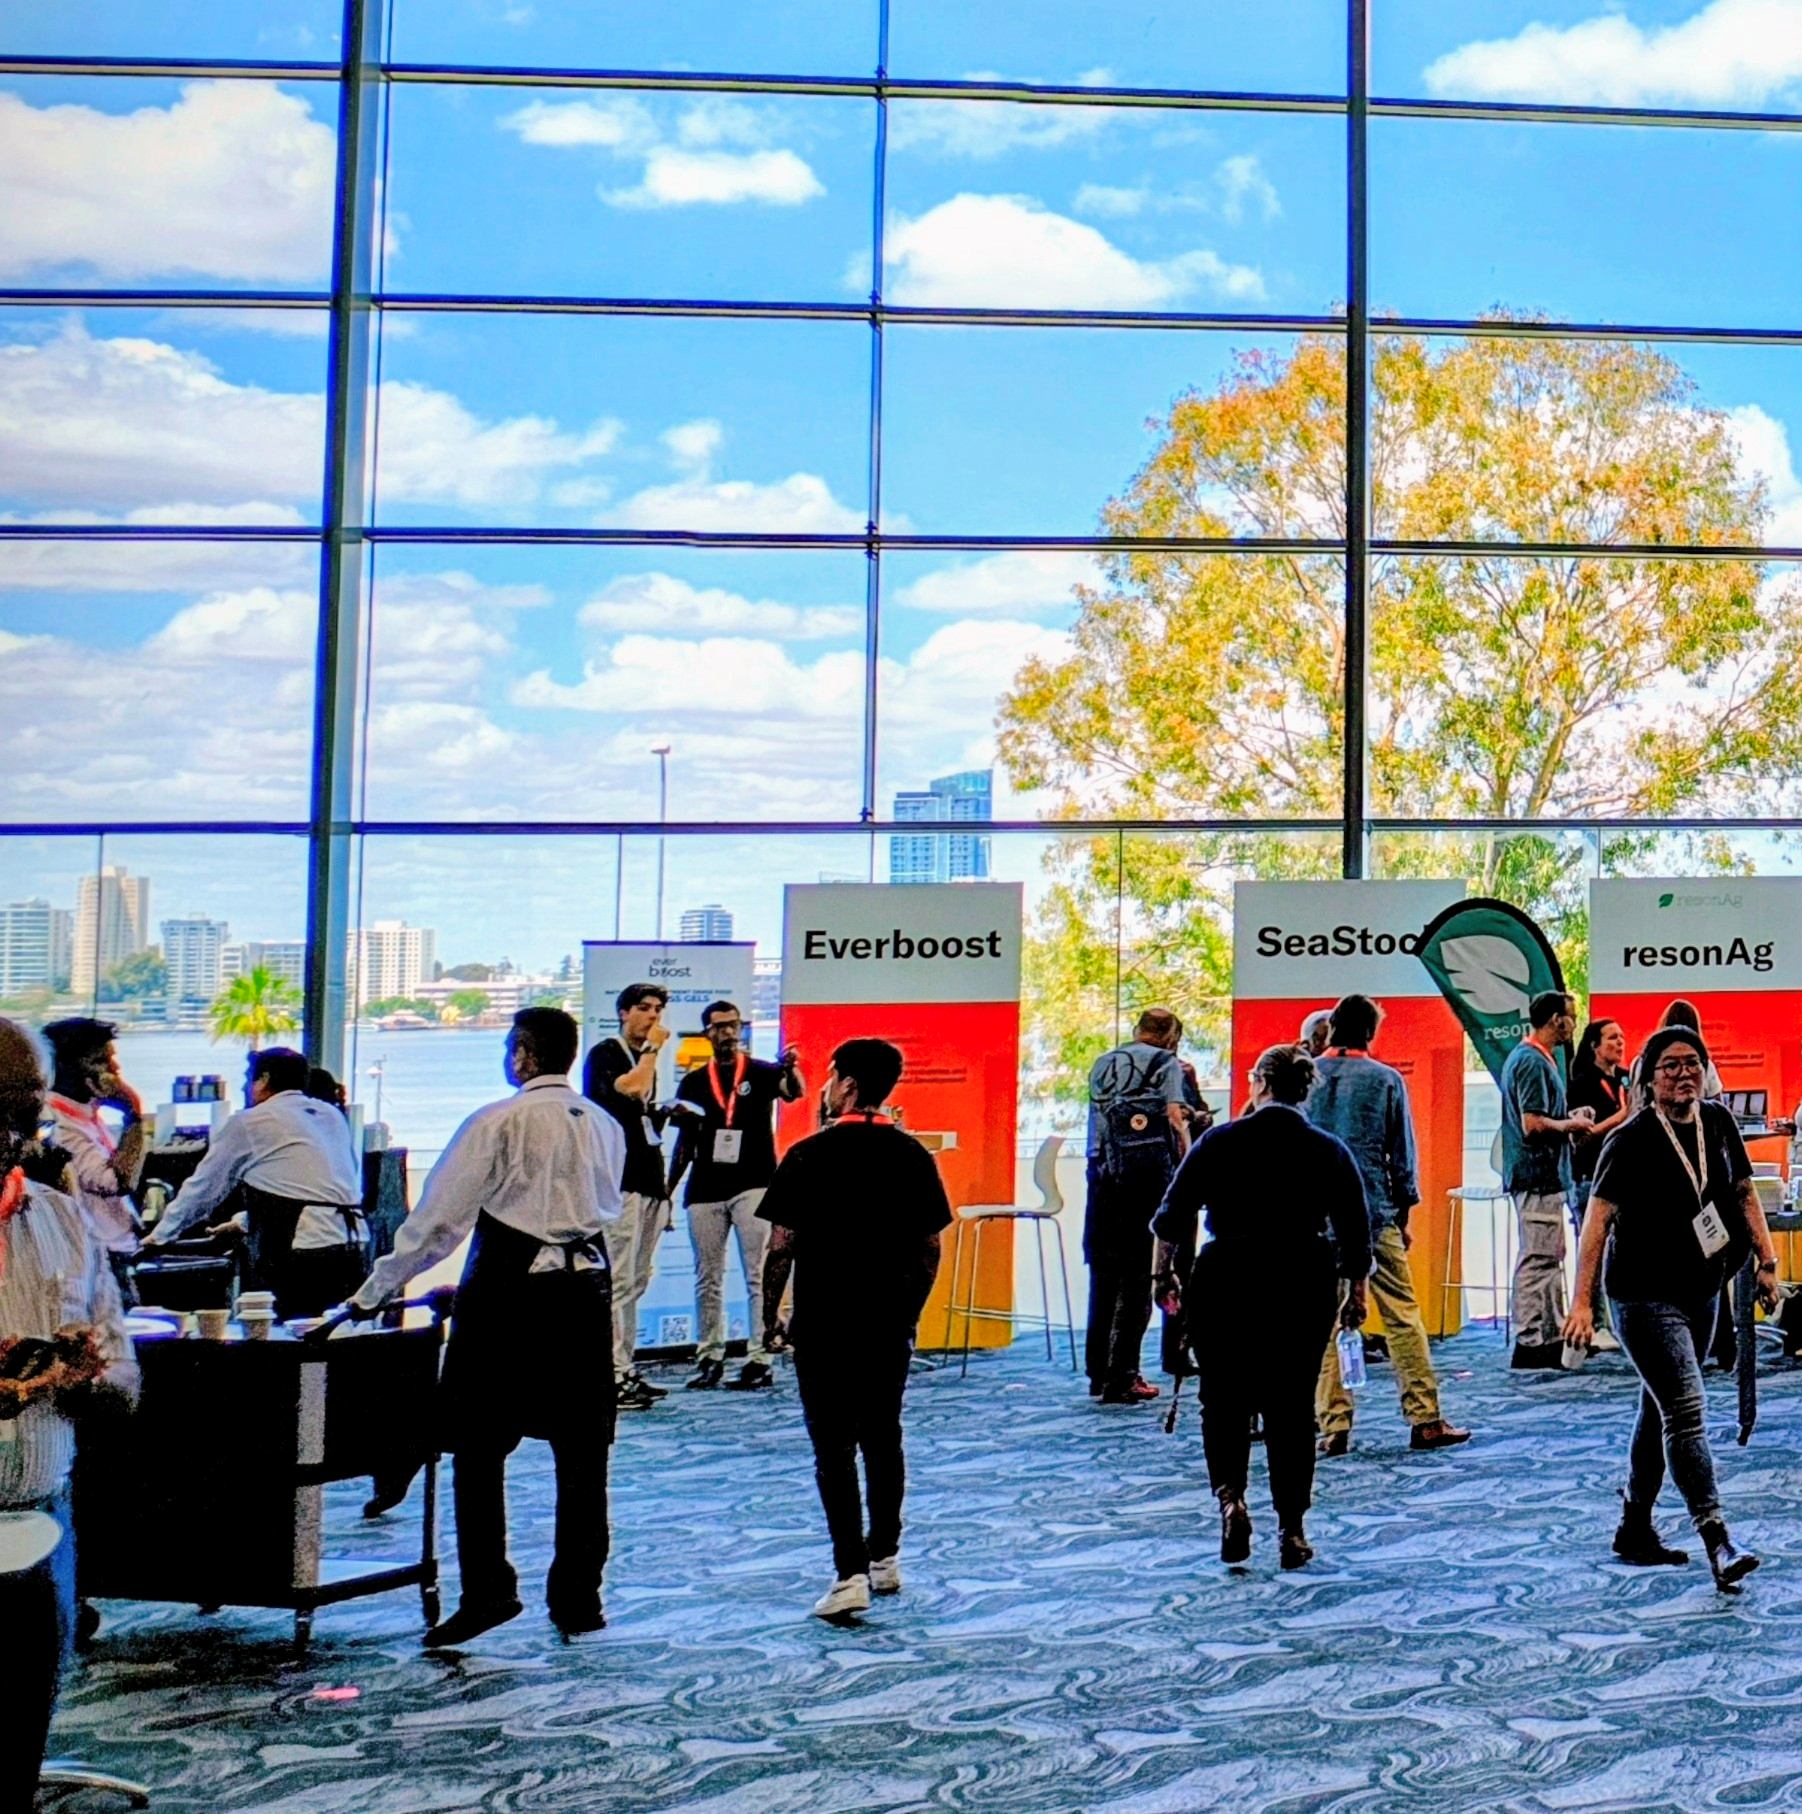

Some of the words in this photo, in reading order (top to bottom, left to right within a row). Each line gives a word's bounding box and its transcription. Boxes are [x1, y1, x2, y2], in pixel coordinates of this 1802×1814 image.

[804, 929, 1002, 959] Everboost
[1256, 925, 1429, 957] SeaStoc
[1623, 937, 1774, 971] resonAg
[652, 958, 678, 966] ever
[1483, 1021, 1532, 1041] reson
